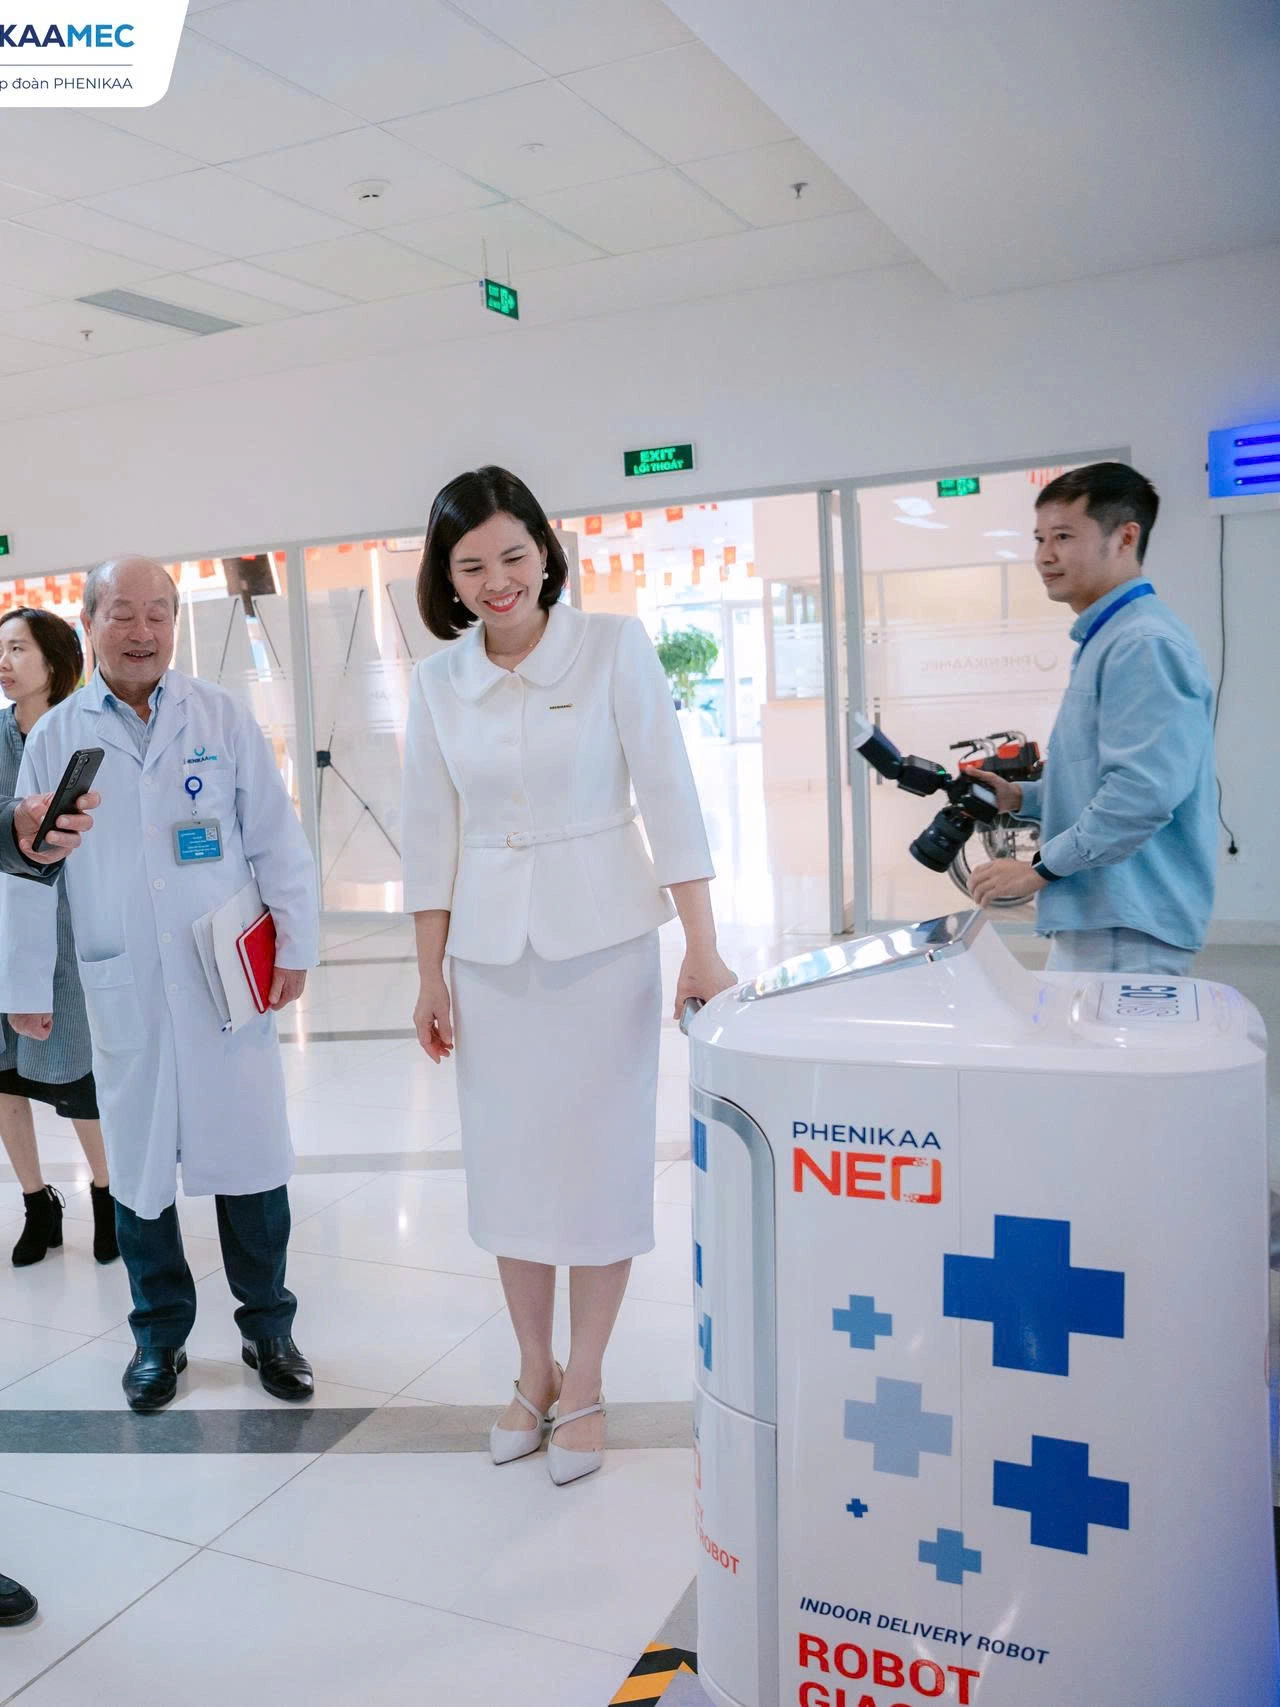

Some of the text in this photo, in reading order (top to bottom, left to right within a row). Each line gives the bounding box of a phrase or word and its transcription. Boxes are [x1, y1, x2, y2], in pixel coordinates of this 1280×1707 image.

[639, 447, 676, 463] EXIT
[792, 1120, 942, 1151] PHENIKAA
[792, 1146, 942, 1205] NEO
[798, 1596, 1051, 1665] INDOOR DELIVERY ROBOT
[798, 1632, 981, 1705] ROBOT
